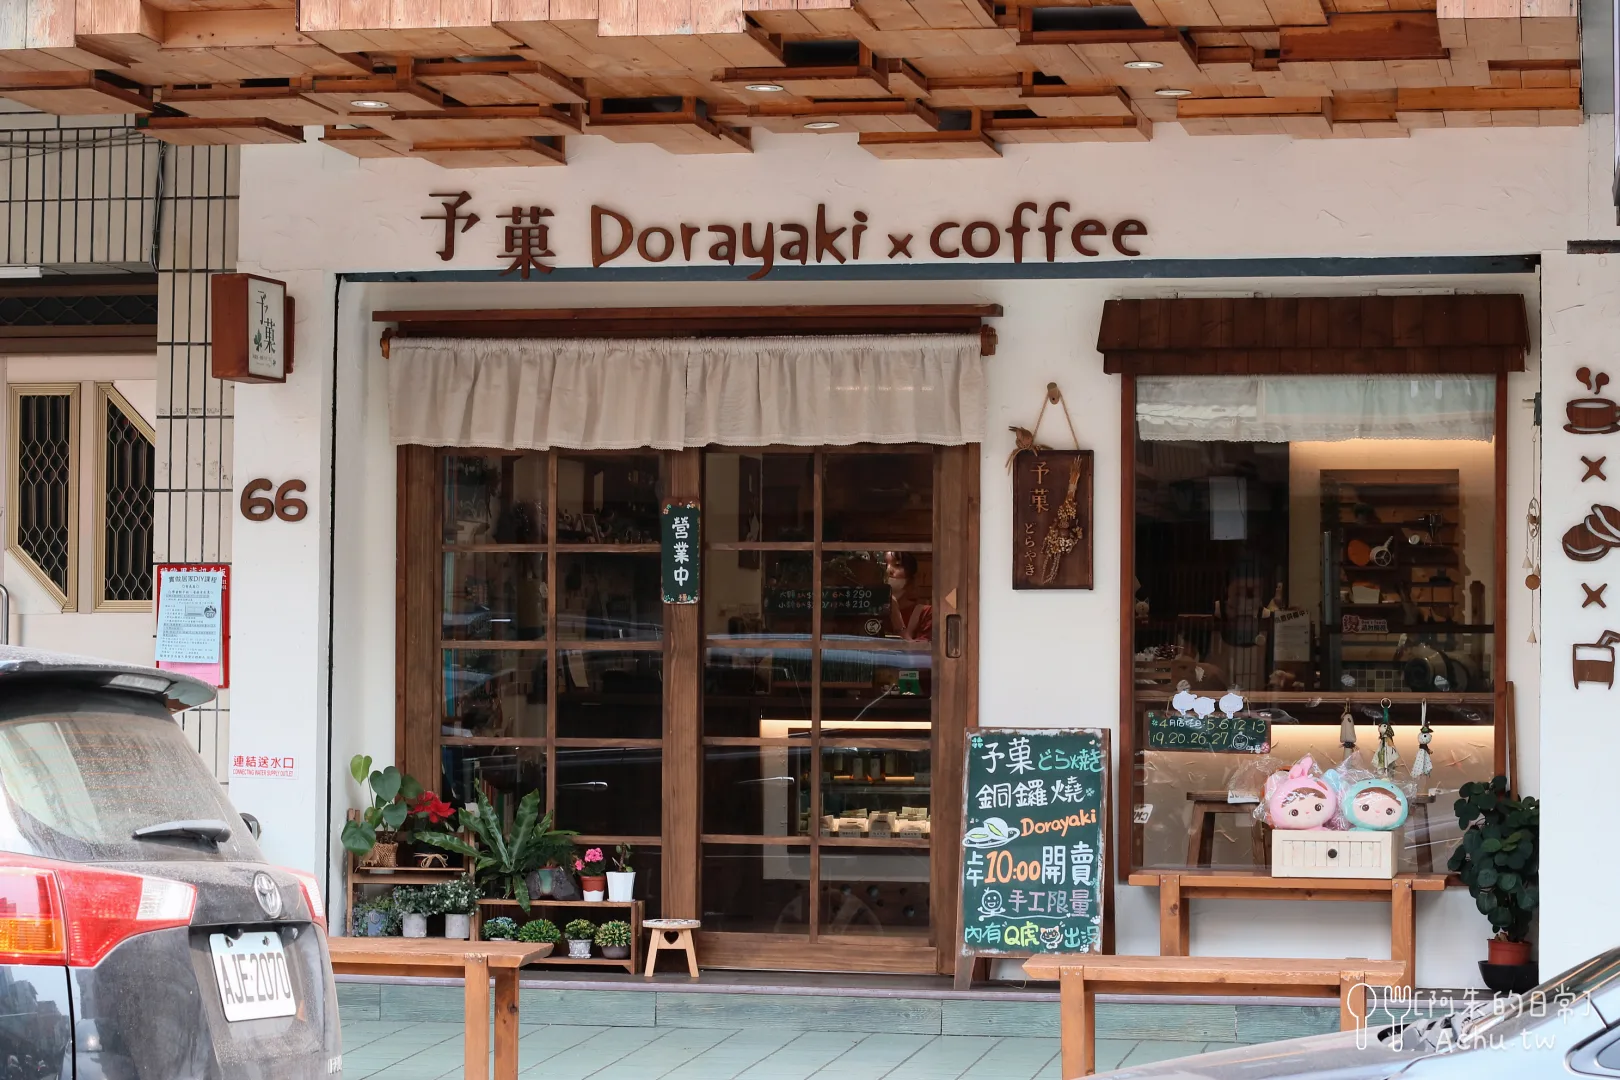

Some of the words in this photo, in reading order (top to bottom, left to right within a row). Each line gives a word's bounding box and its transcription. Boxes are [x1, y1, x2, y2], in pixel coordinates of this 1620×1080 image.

[421, 190, 557, 279] 予菓
[590, 203, 868, 281] Dorayaki
[929, 201, 1148, 263] coffee
[240, 478, 308, 522] 66
[1029, 461, 1050, 513] 予菓
[671, 516, 690, 587] 營業中
[1024, 522, 1037, 576] どらやき
[233, 755, 294, 769] 連結送水口
[975, 776, 1086, 809] 銅鑼燒
[1020, 809, 1097, 837] Dorayaki
[1008, 889, 1093, 918] 手工限量
